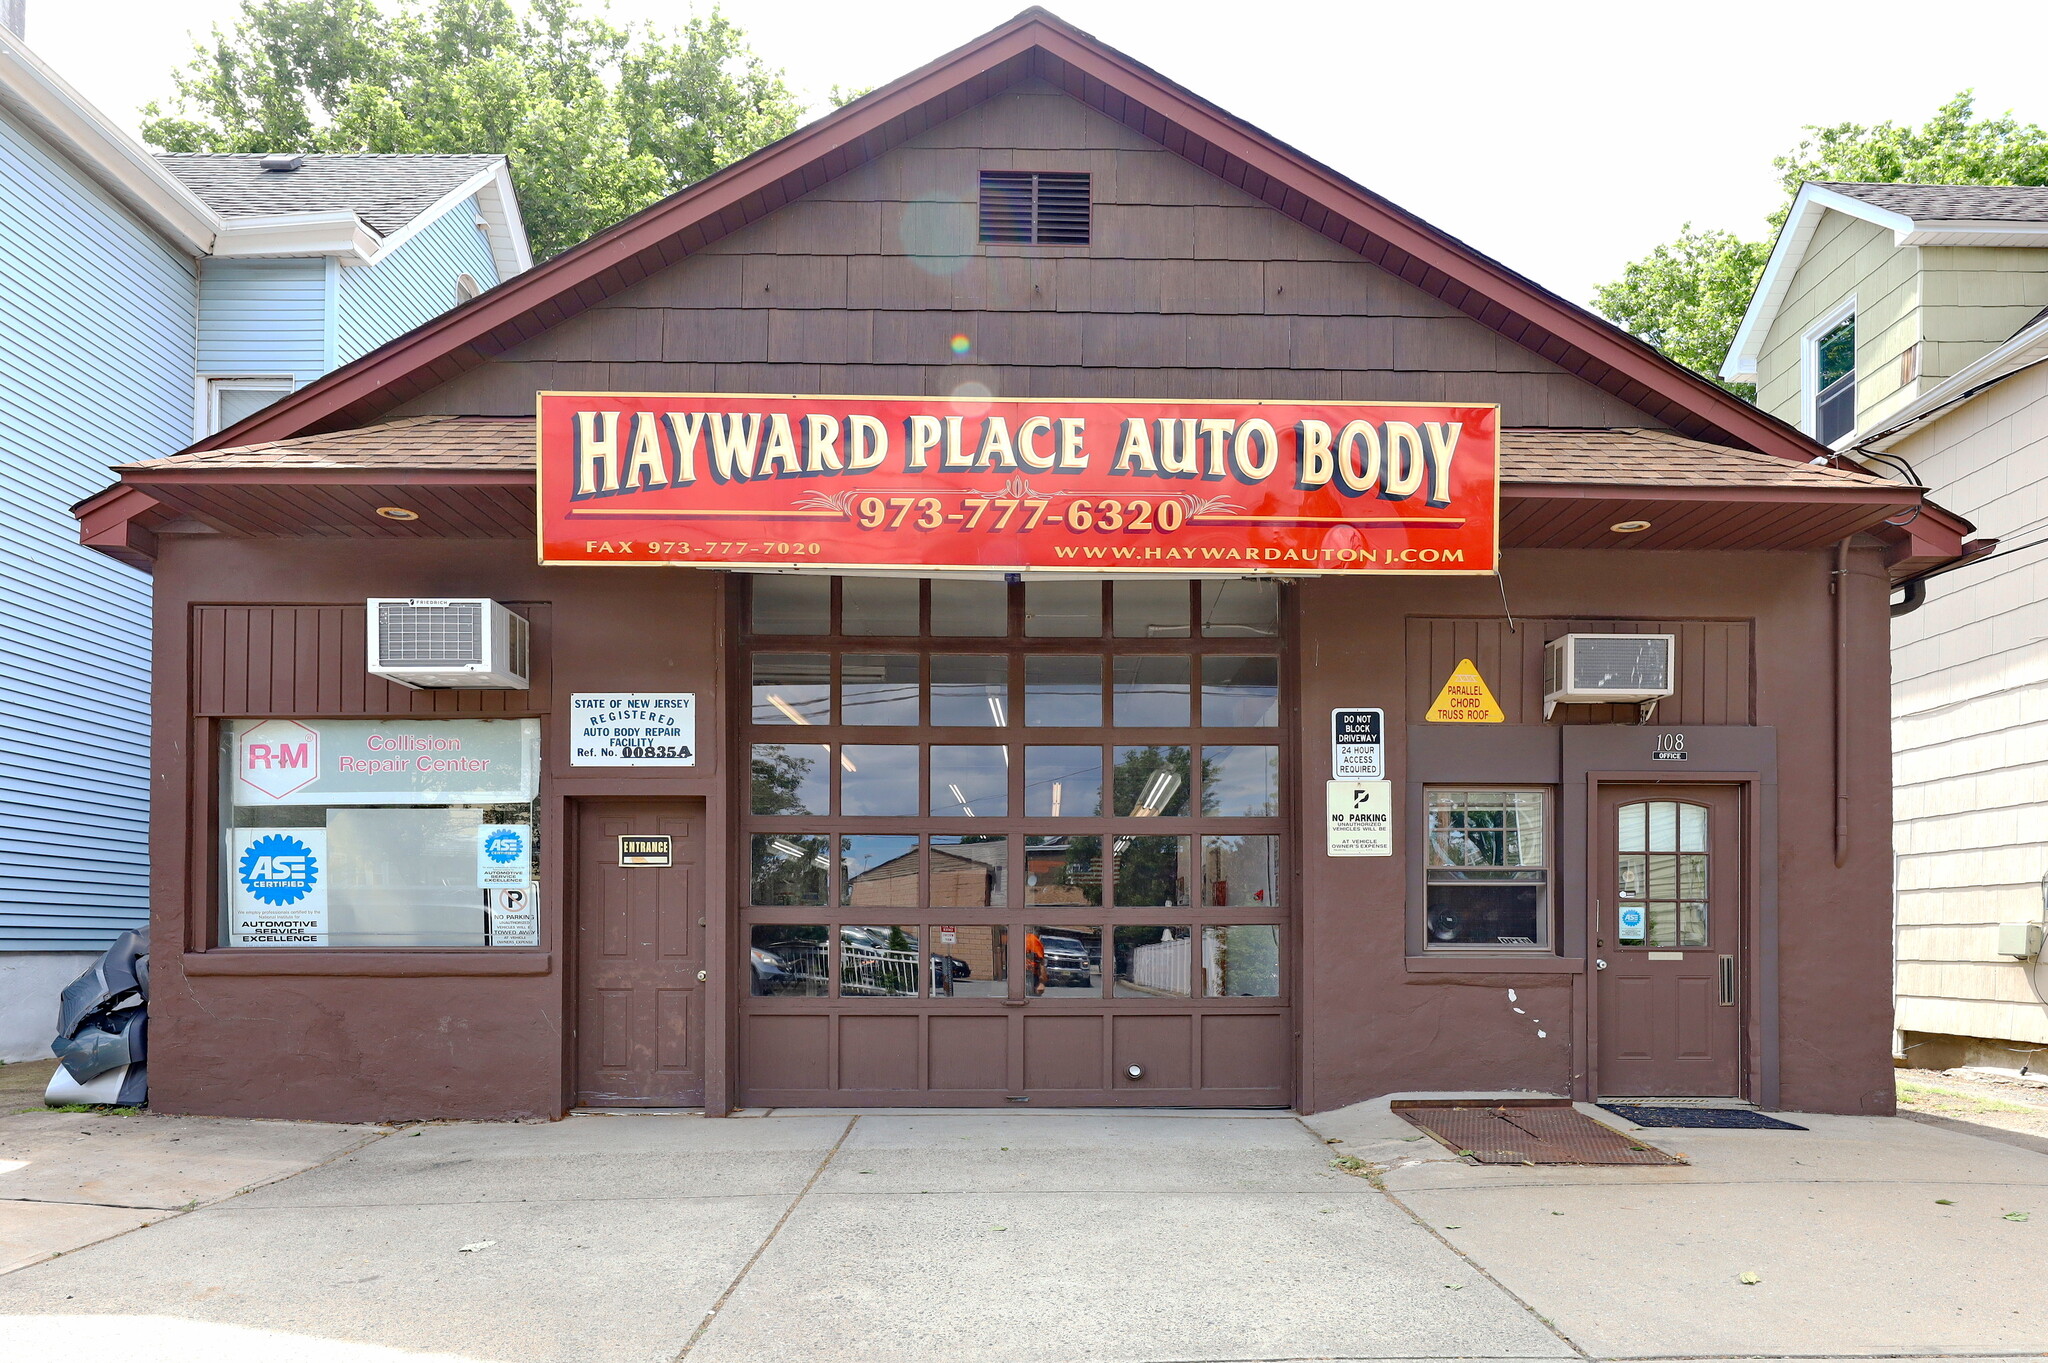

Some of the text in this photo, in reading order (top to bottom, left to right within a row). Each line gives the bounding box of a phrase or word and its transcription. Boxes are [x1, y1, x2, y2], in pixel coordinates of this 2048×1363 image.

[573, 411, 1463, 506] HAYWARD PLACE AUTO BODY
[858, 496, 1183, 532] 973-777-6320
[586, 540, 822, 556] FAX 973-777-7020
[1054, 545, 1465, 564] WWW.HAYWARDAUTONJ.COM
[1447, 685, 1483, 696] PARALLEL
[574, 699, 690, 709] STATE OF NEW JERSEY
[1450, 697, 1481, 708] CHORD
[590, 710, 675, 726] REGISTERED
[1344, 715, 1371, 723] DO NOT
[1438, 709, 1489, 720] TRUSS ROOF
[583, 727, 681, 737] AUTO BODY REPAIR
[1345, 724, 1370, 732] BLOCK
[367, 734, 461, 751] Collision
[609, 737, 654, 747] FACILITY
[1338, 734, 1377, 742] DRIVEWAY
[1656, 733, 1684, 751] 108
[577, 745, 693, 757] Ref. No. 00835A
[1341, 746, 1374, 754] 24 HOUR
[248, 743, 308, 770] R-M
[339, 755, 491, 775] Repair Center
[1340, 765, 1377, 773] REQUIRED
[1332, 814, 1387, 822] NO PARKING
[488, 839, 518, 851] ASE
[623, 841, 668, 853] ENTRANCE
[248, 855, 306, 880] ASE
[253, 880, 305, 888] CERTIFIED
[241, 920, 318, 928] AUTOMOTIVE
